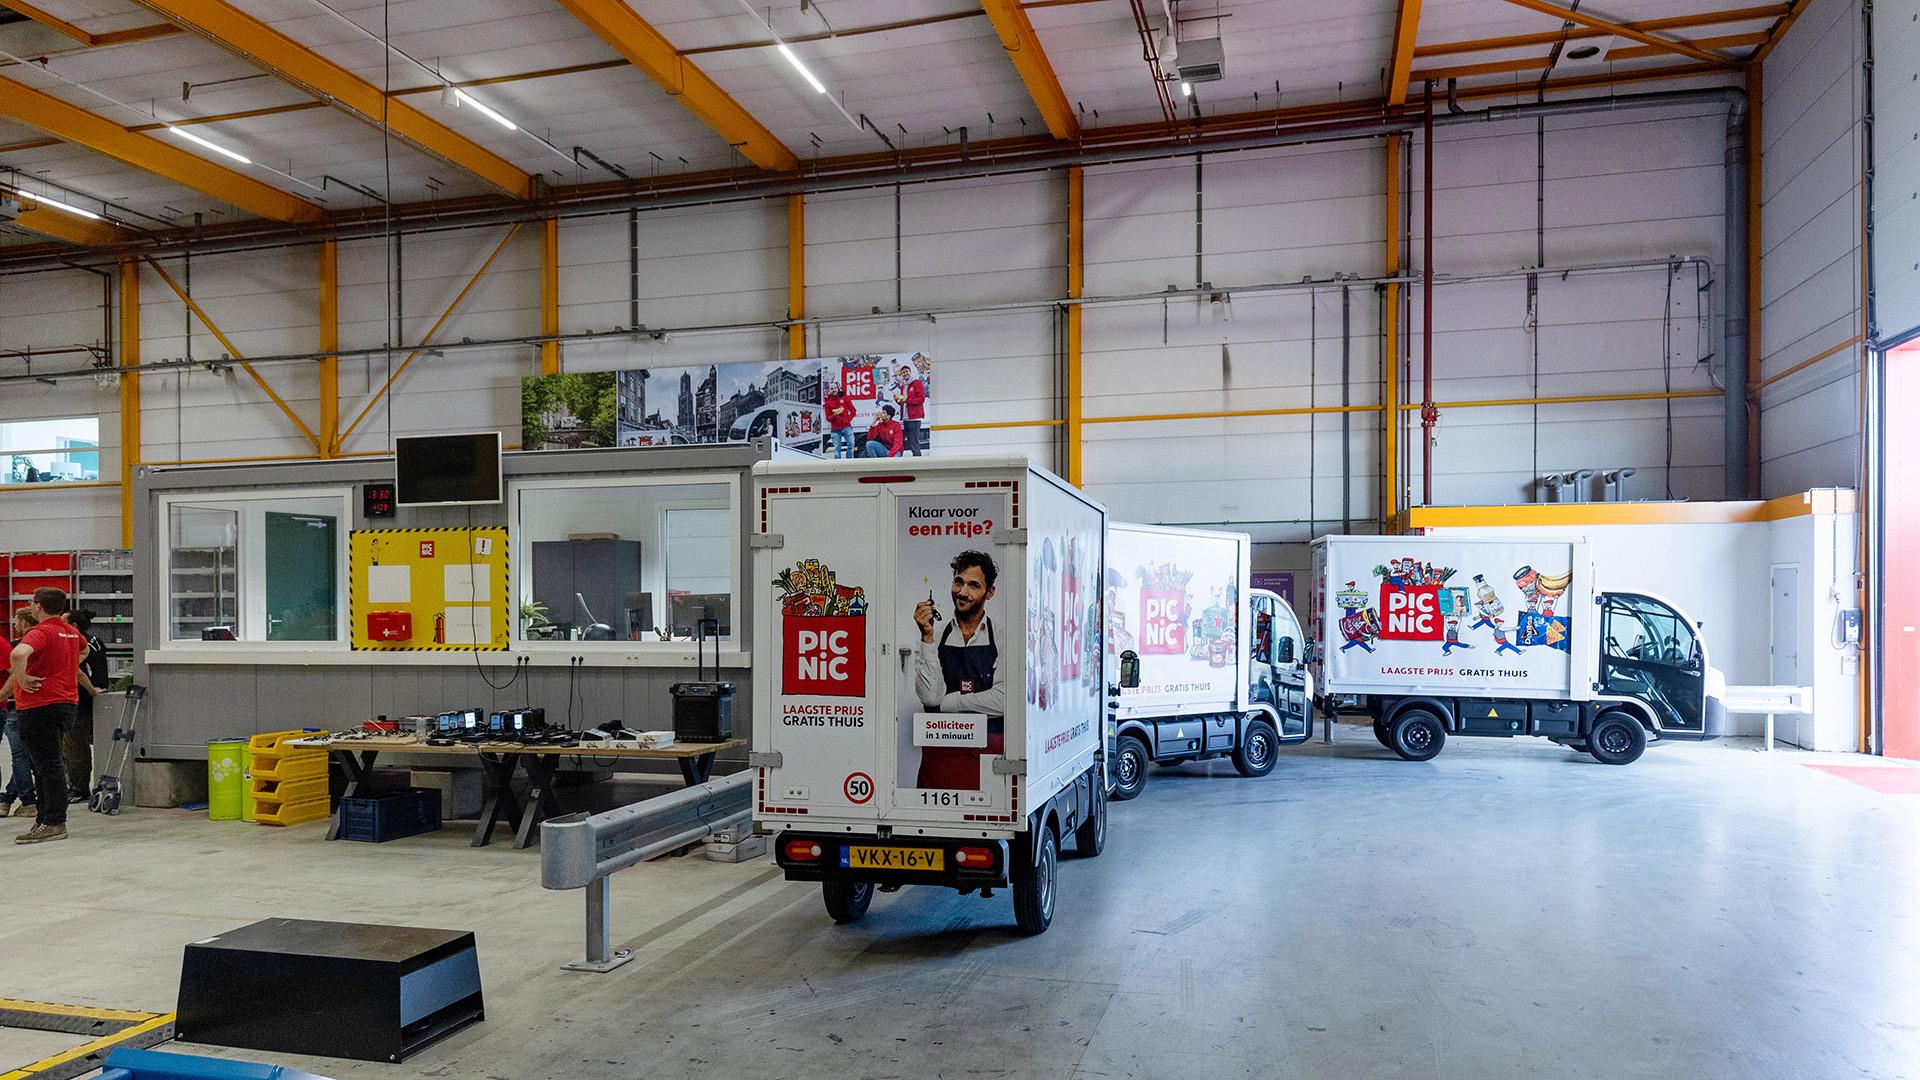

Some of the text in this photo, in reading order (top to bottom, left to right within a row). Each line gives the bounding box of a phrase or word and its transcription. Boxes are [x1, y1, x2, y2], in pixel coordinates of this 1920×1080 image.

[846, 371, 870, 383] PIC
[909, 506, 979, 518] Klaar voor
[909, 520, 993, 538] een ritje?
[1064, 592, 1079, 626] PIC
[1390, 593, 1434, 612] PIC
[1146, 600, 1178, 621] PIC
[798, 630, 848, 654] PIC
[1381, 667, 1424, 675] LAAGSTE
[1459, 668, 1494, 676] GRATIS
[1498, 670, 1528, 678] THUIS
[1142, 685, 1161, 694] PRIJS
[1165, 684, 1189, 692] GRATIS
[1191, 683, 1210, 691] THUIS
[783, 705, 864, 715] LAAGSTE PRIJS
[783, 716, 864, 727] GRATIS THUIS
[926, 721, 974, 729] Solliciteer
[850, 781, 868, 795] 50
[921, 792, 959, 806] 1161
[857, 849, 935, 867] VKX-16-V
